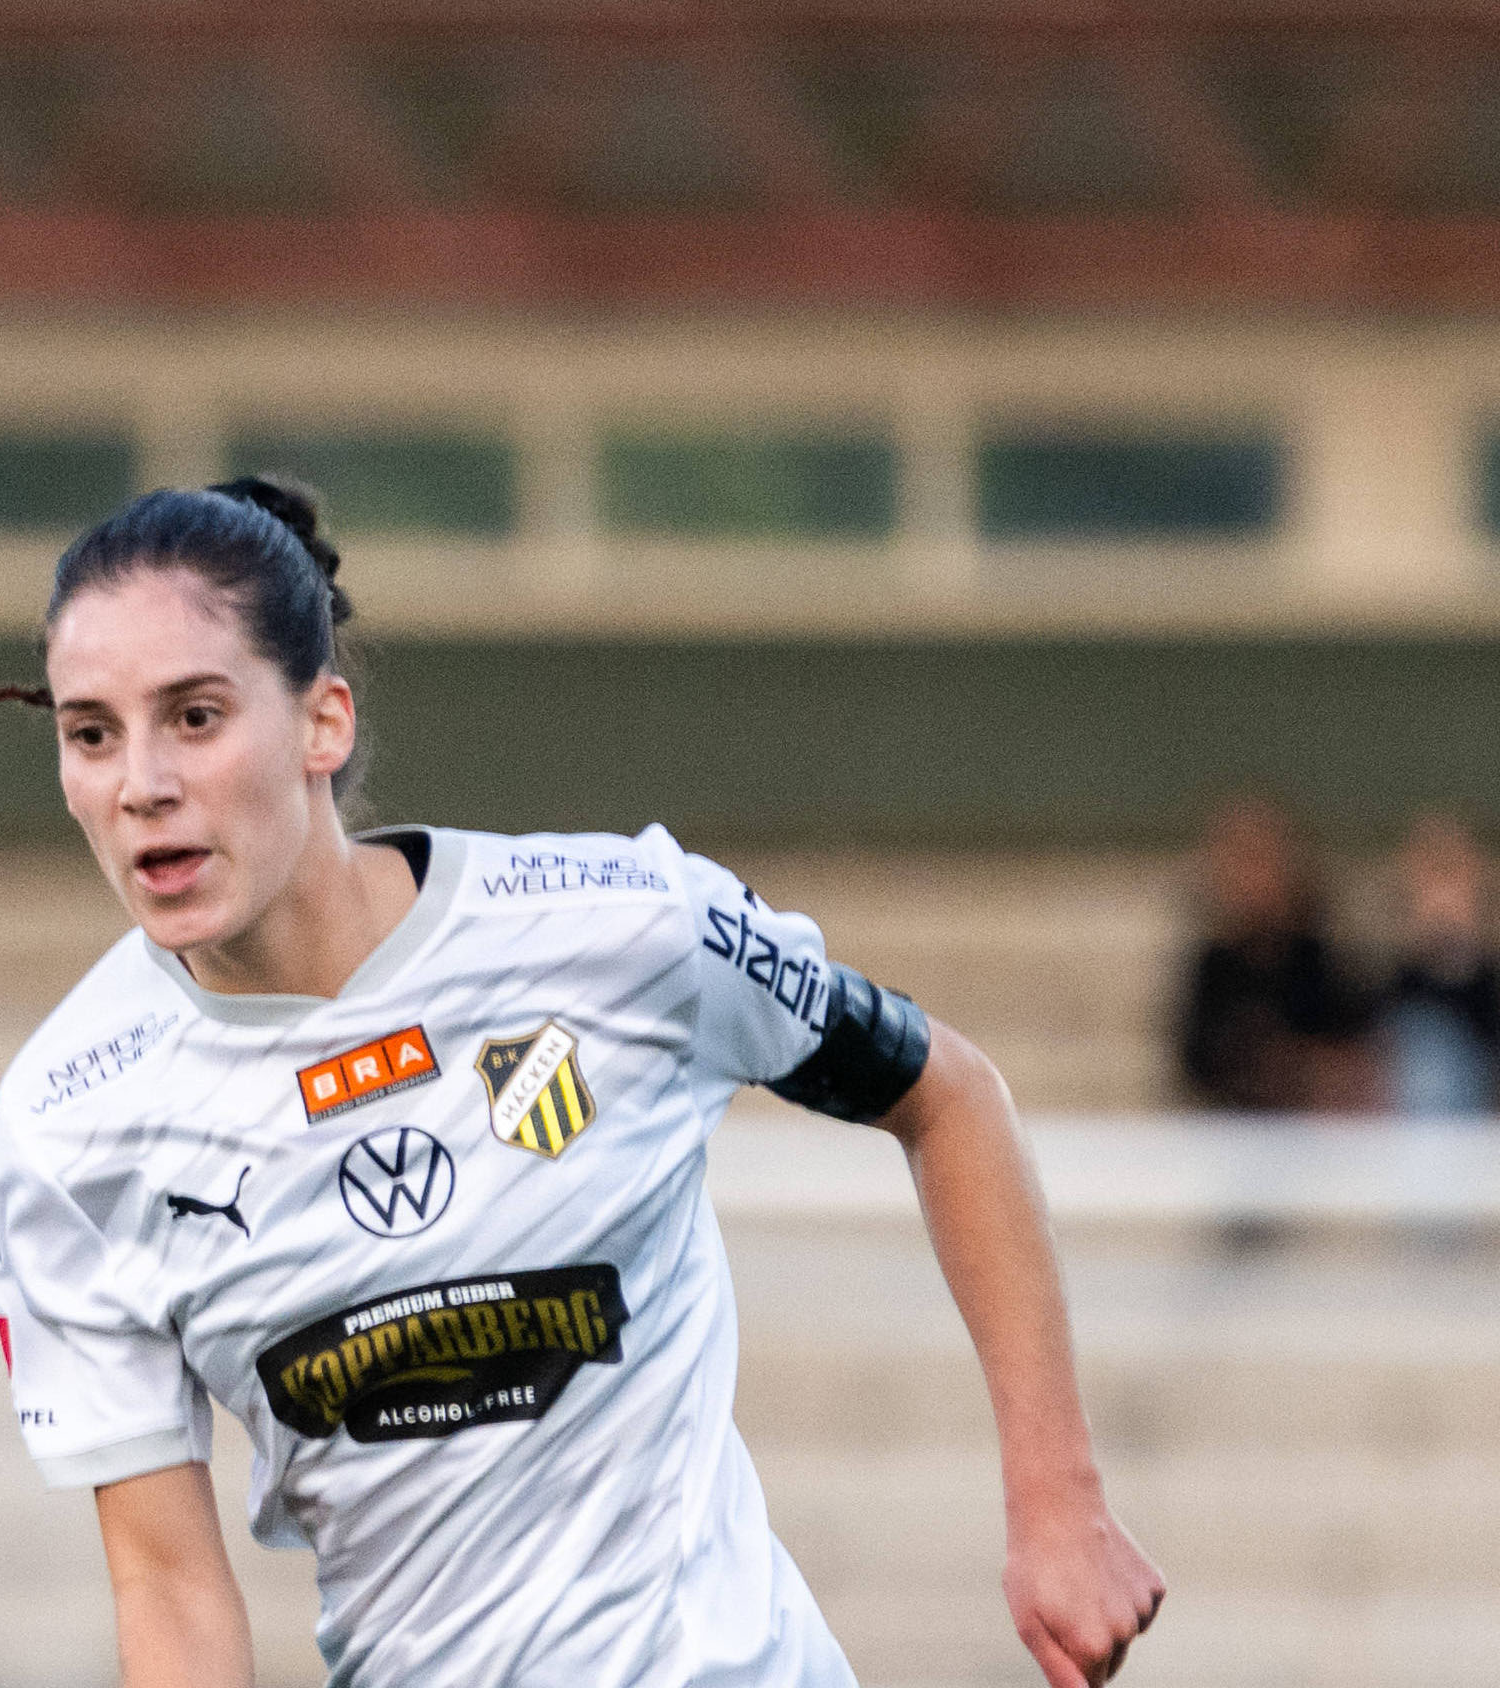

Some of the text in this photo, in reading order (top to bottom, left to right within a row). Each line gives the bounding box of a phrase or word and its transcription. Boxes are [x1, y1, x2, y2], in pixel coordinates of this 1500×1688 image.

[483, 871, 670, 897] WELLNESS
[510, 852, 637, 872] NORDIC
[311, 1041, 425, 1101] BRA
[343, 1281, 517, 1336] PREMIUM CIDER
[281, 1289, 607, 1425] KOPPARBERG
